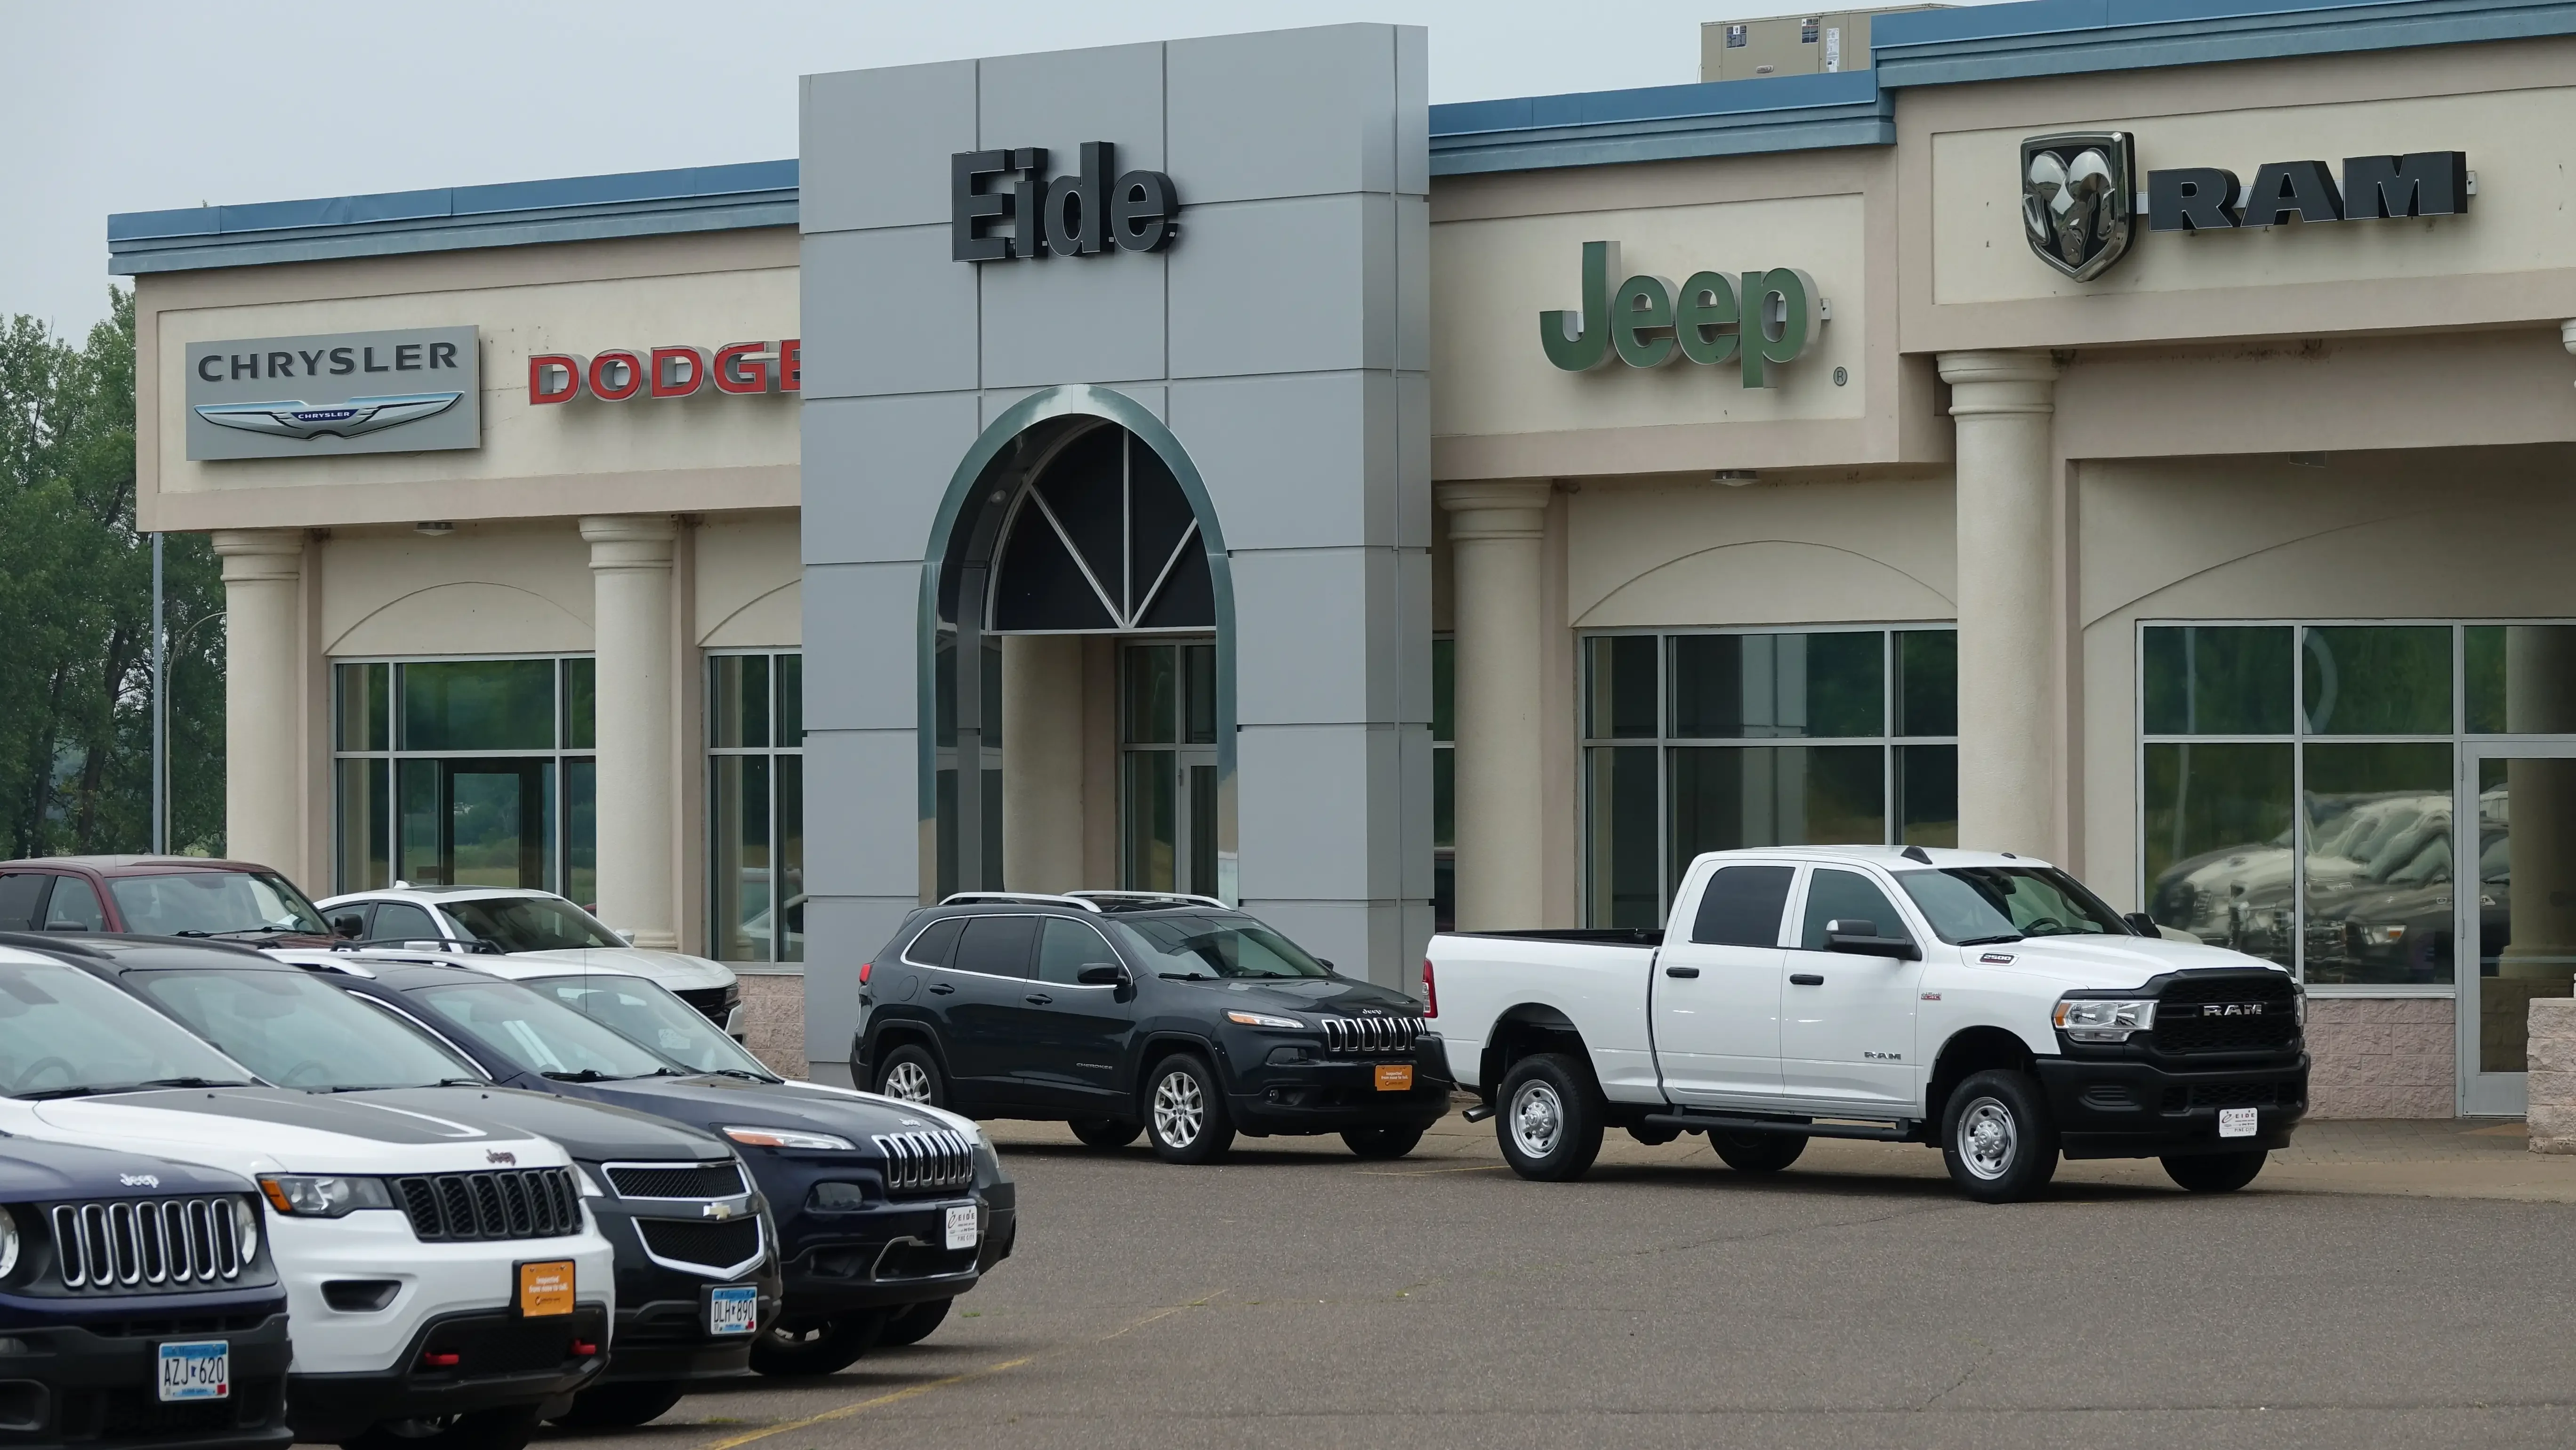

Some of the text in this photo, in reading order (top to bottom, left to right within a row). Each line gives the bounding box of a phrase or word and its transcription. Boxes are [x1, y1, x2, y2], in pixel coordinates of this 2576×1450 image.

[951, 141, 1178, 262] Eide
[2148, 150, 2468, 232] RAM
[1539, 241, 1821, 389] Jeep
[198, 342, 458, 382] CHRYSLER
[2204, 1004, 2262, 1016] RAM
[1864, 1050, 1901, 1060] RAM
[120, 1173, 159, 1189] Jeep
[958, 1212, 975, 1222] EIDE
